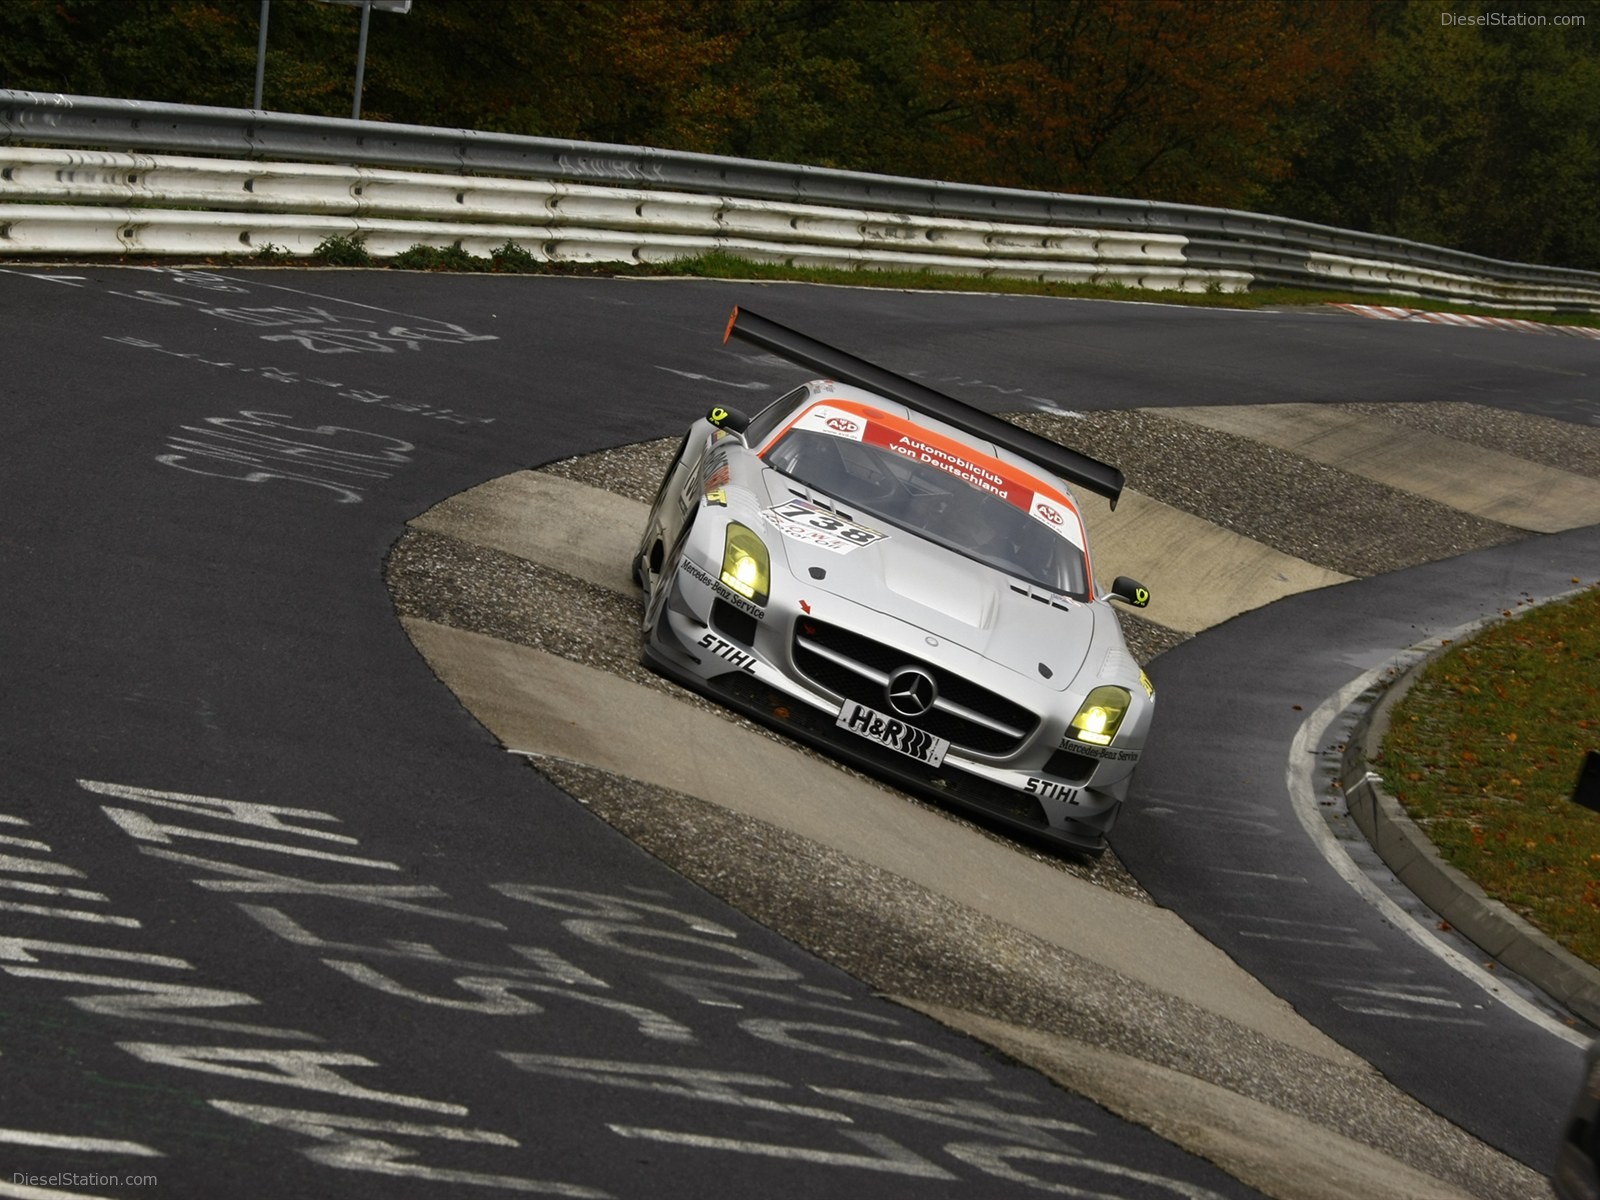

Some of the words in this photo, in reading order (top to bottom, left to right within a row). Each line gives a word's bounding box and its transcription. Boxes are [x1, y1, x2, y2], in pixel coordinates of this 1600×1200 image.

[889, 443, 917, 458] von
[920, 453, 1008, 499] Deutschland
[899, 435, 1003, 486] Automobilclub
[781, 504, 876, 543] 738
[681, 559, 731, 600] Mercedes-Benz
[731, 594, 765, 620] Service
[697, 634, 757, 675] STIHL
[848, 705, 903, 746] H&R
[1059, 739, 1118, 761] Mercedes-Benz
[1024, 778, 1079, 806] STIHL
